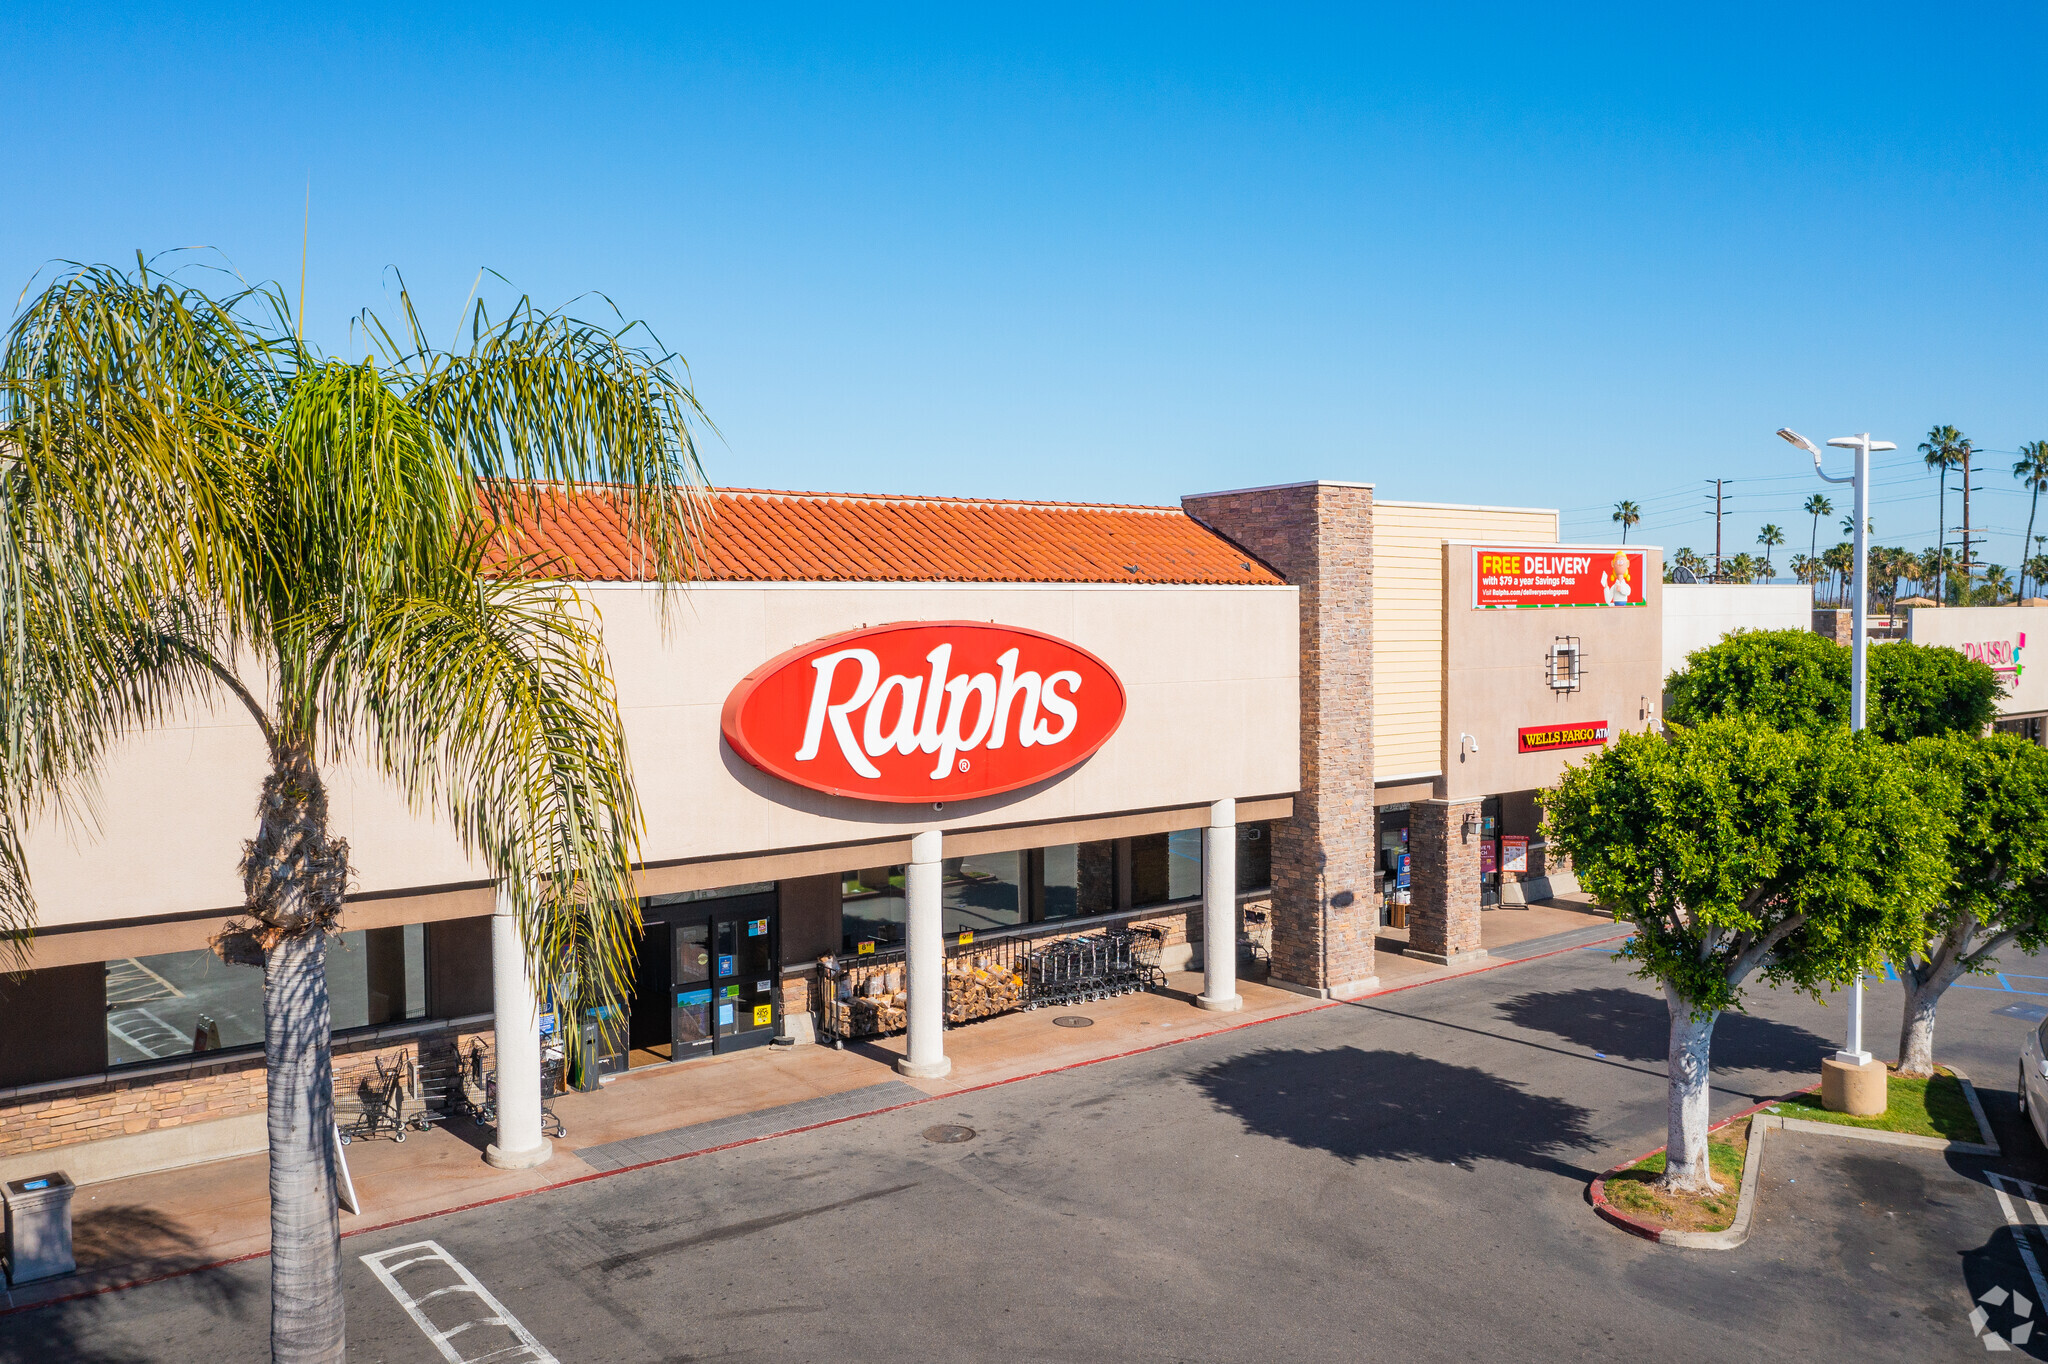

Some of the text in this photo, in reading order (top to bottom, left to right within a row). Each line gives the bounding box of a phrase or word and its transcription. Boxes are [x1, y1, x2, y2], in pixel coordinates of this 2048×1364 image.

[1482, 556, 1591, 574] FREE DELIVERY
[1482, 575, 1498, 585] with
[1499, 576, 1513, 586] $79
[1519, 577, 1534, 587] year
[1535, 576, 1560, 587] Savings
[1561, 576, 1575, 585] Pass
[1964, 640, 2012, 664] DAISO
[795, 643, 1082, 779] Ralphs
[1526, 727, 1610, 745] WELLS FARGO ATM
